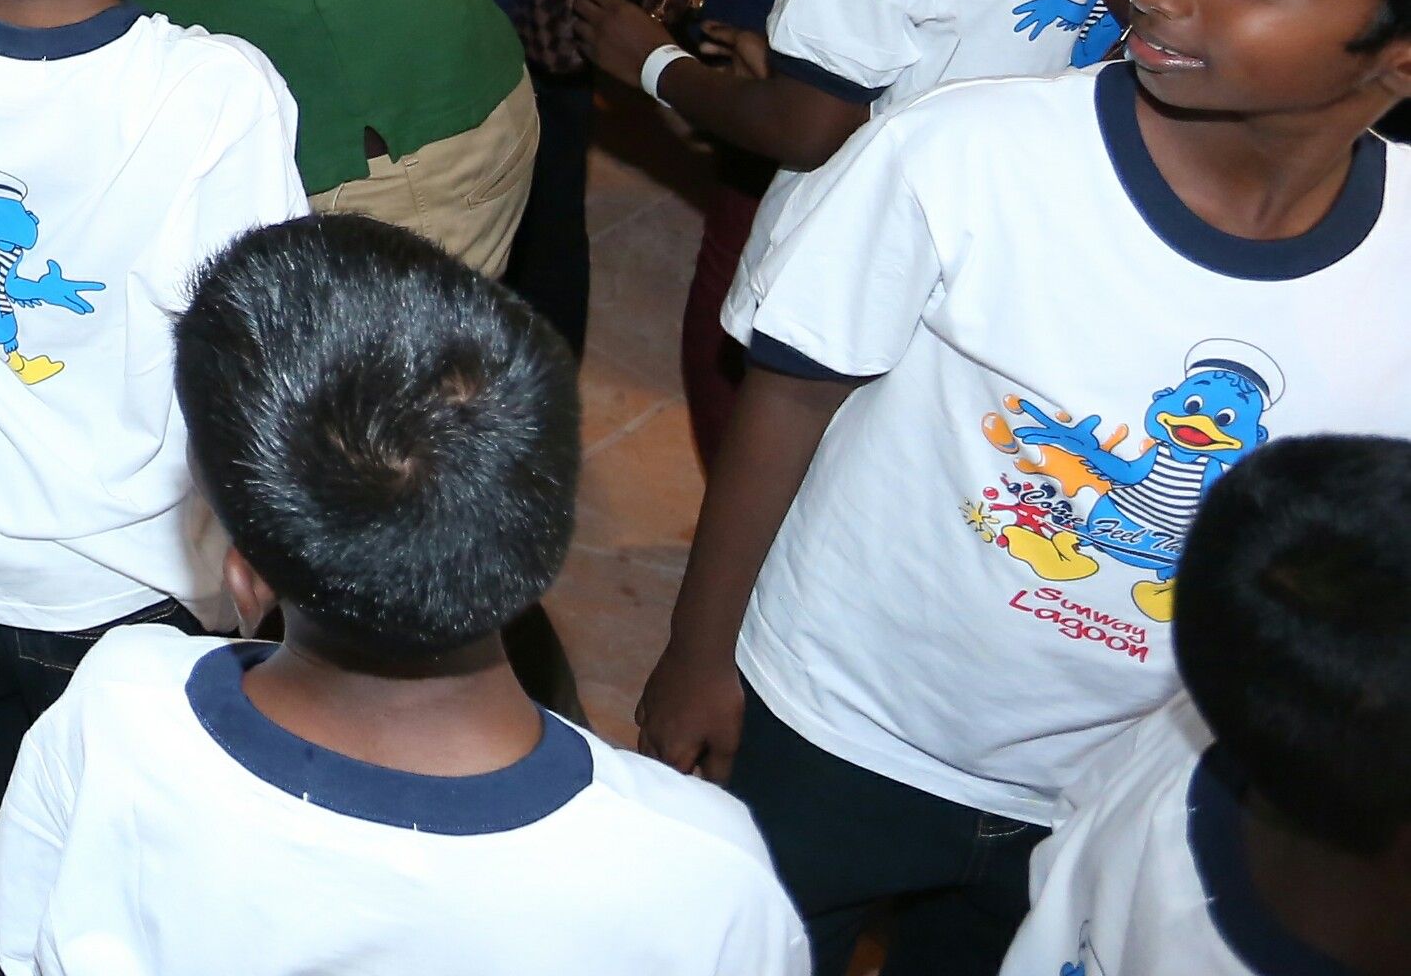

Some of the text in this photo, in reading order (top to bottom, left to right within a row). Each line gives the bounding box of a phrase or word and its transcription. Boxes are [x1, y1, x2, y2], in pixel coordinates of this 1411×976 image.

[1089, 518, 1142, 544] Feel
[1009, 589, 1149, 663] Lagoon
[1033, 587, 1146, 644] Sunway
